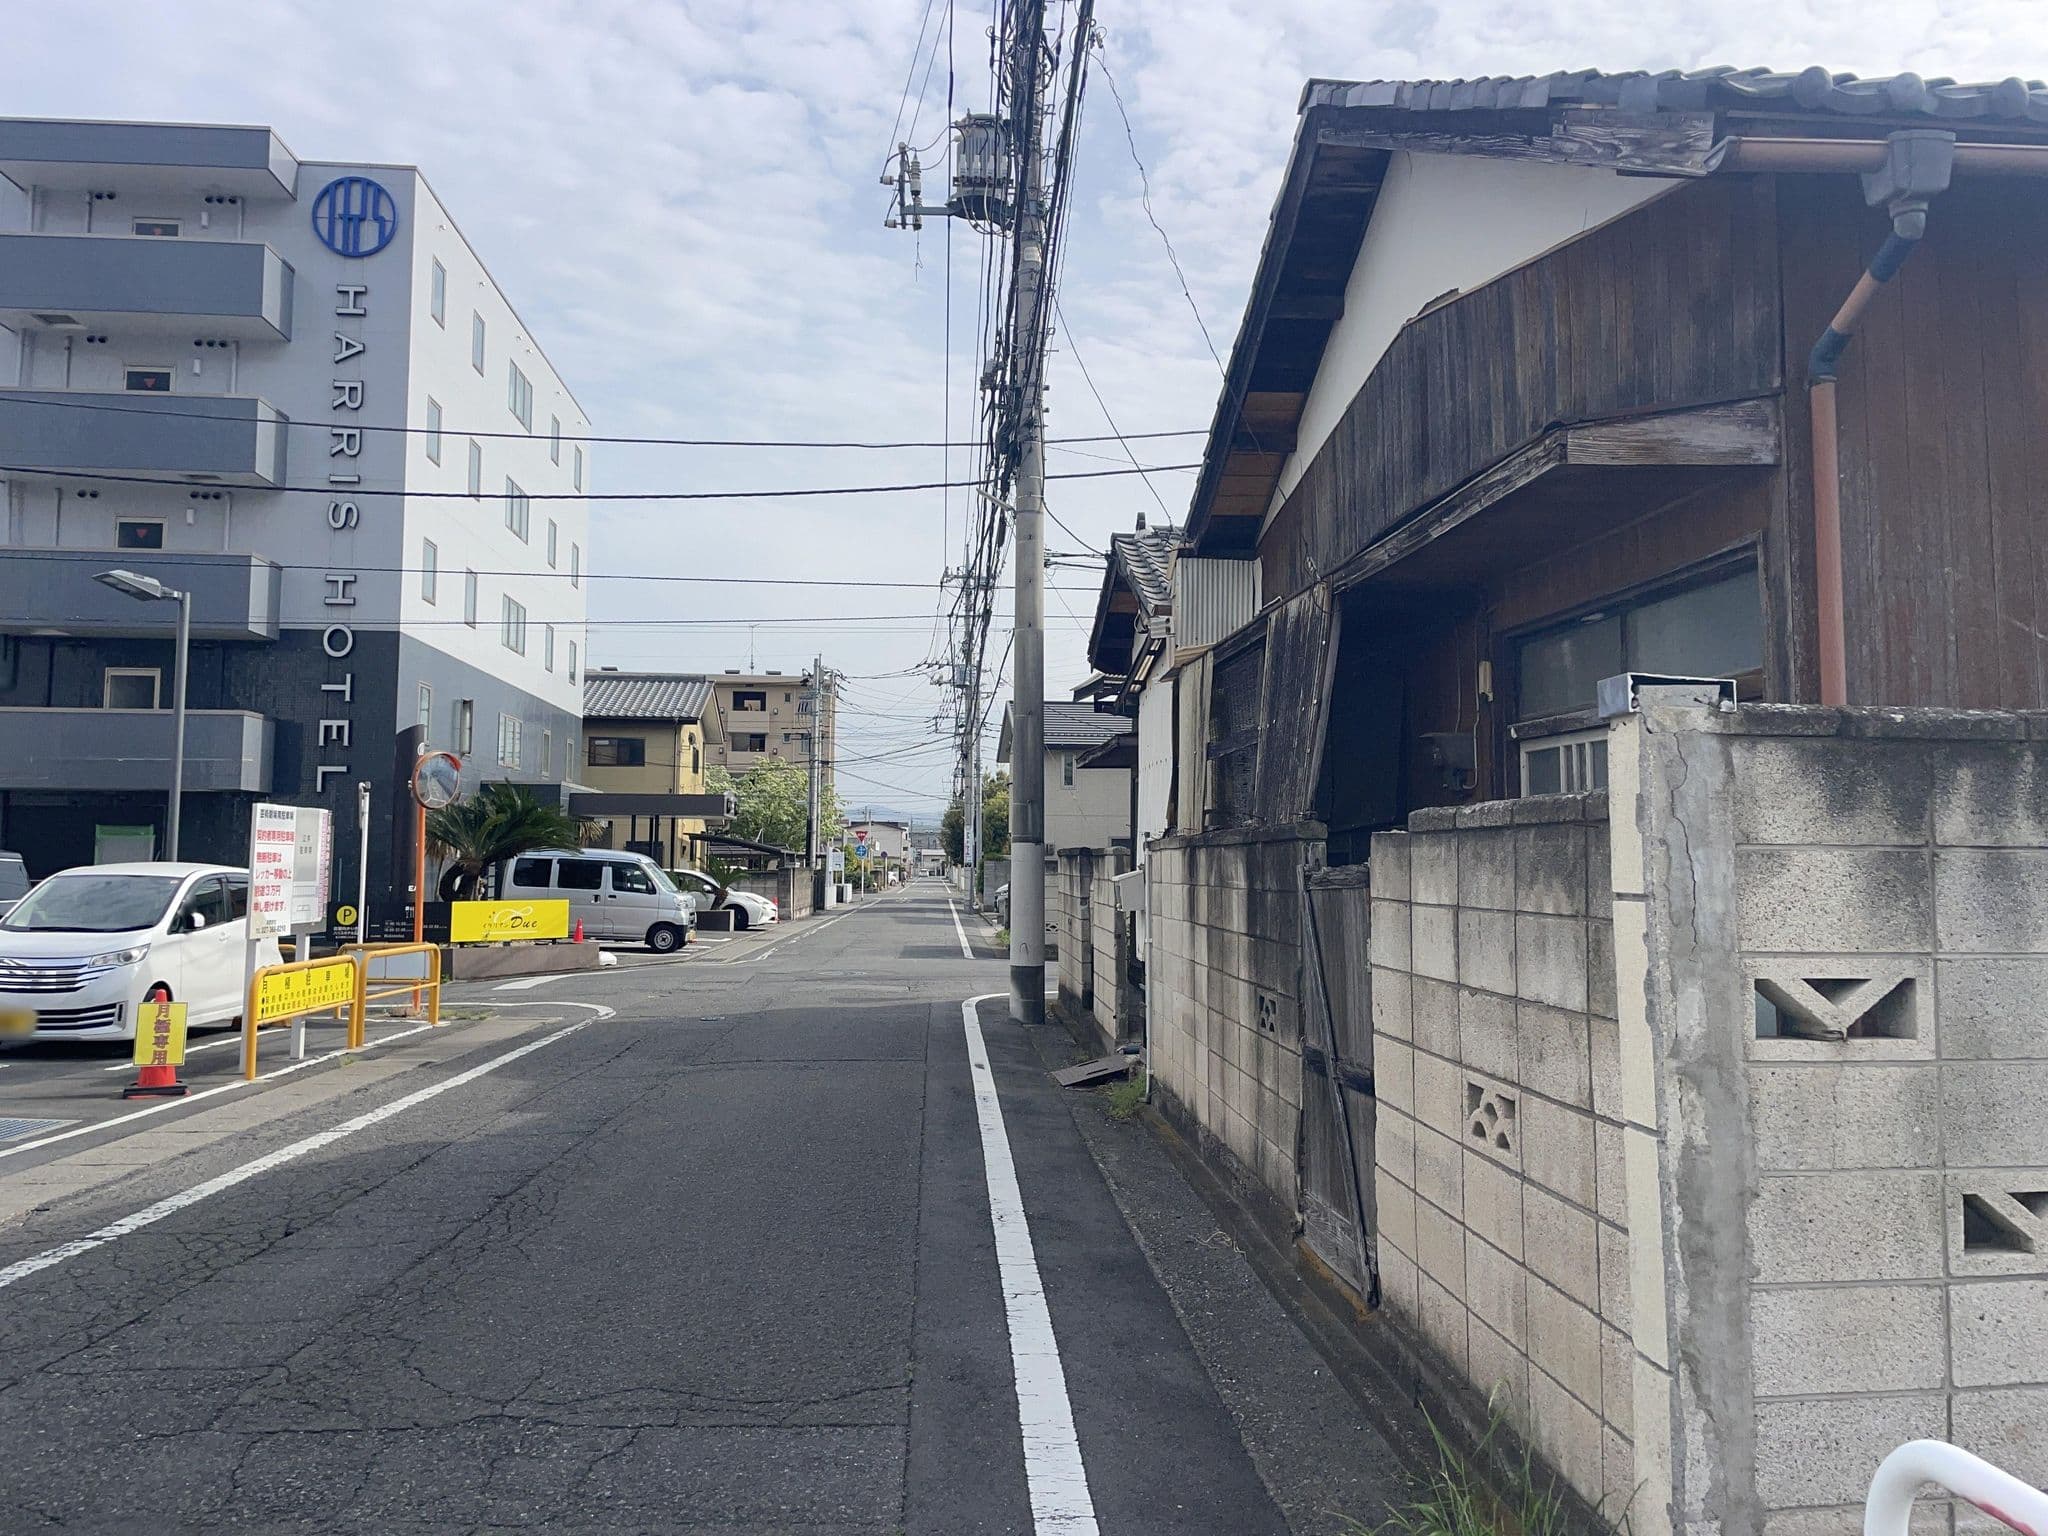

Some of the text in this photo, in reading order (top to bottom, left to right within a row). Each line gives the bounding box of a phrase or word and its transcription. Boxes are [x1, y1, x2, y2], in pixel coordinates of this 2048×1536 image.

[328, 284, 368, 532] HARRIS
[316, 573, 357, 794] HOTEL
[257, 852, 282, 863] 無断駐車は
[510, 916, 538, 929] Due
[151, 1004, 171, 1065] 月極専用
